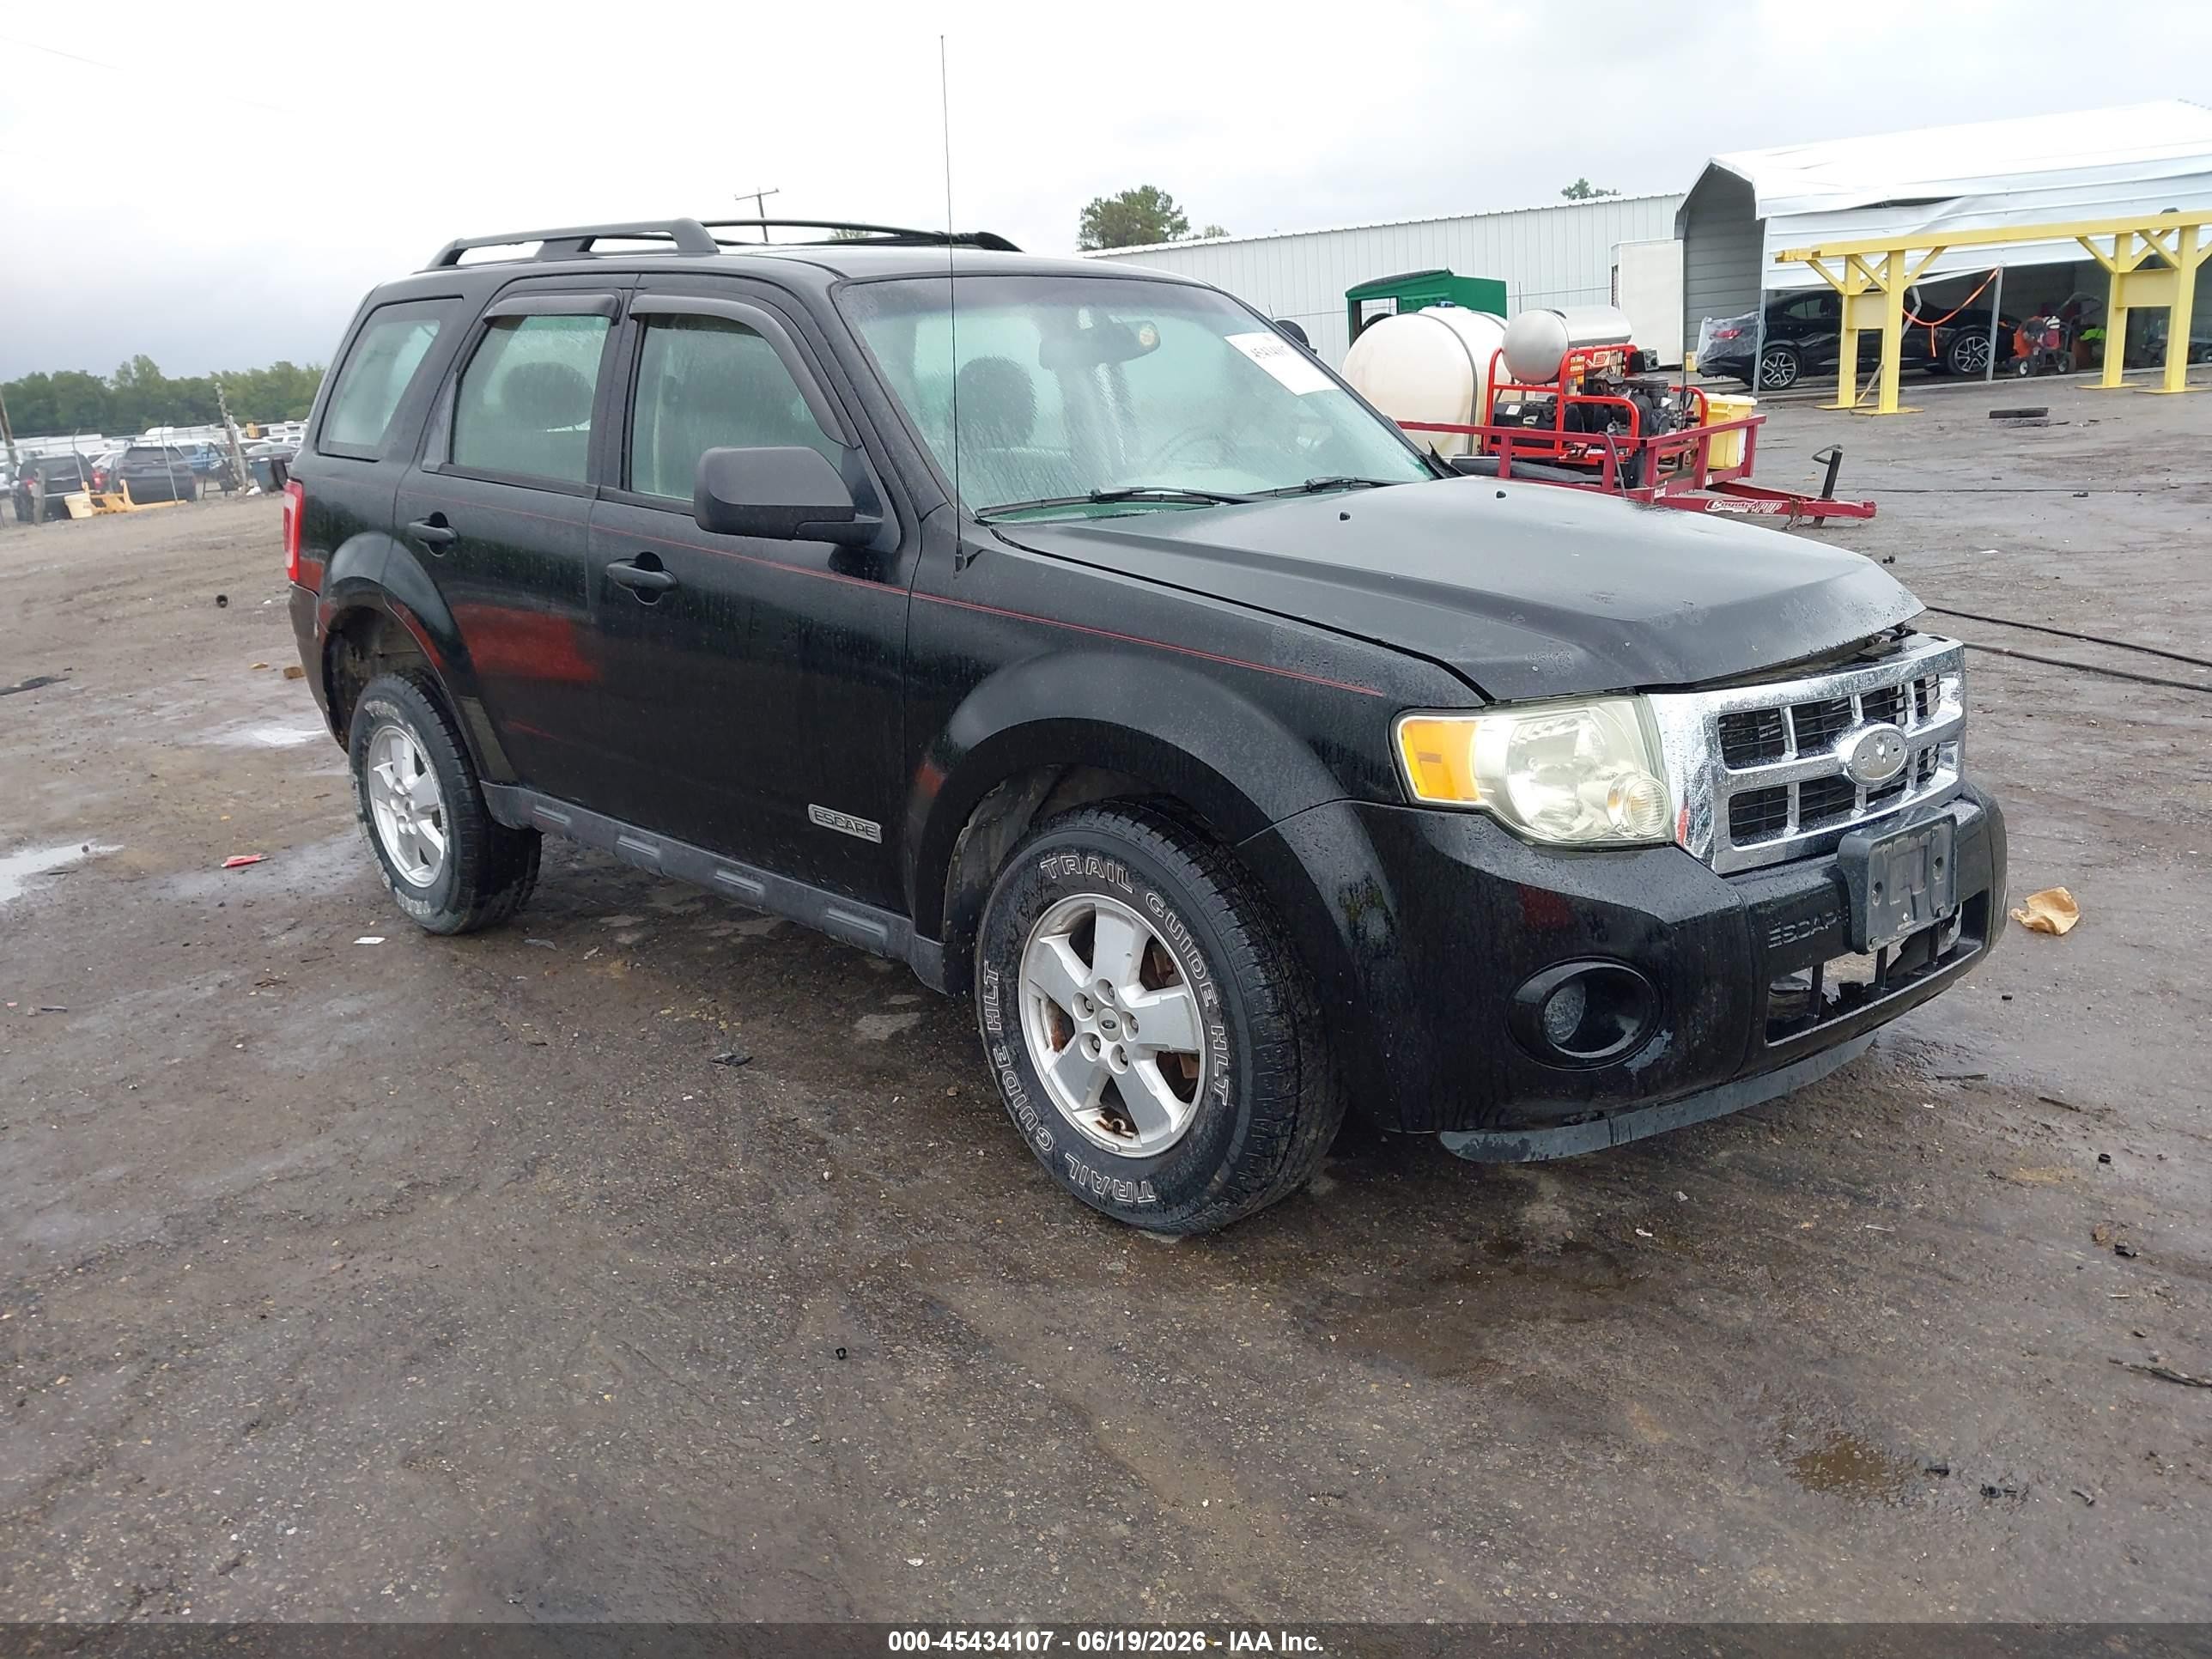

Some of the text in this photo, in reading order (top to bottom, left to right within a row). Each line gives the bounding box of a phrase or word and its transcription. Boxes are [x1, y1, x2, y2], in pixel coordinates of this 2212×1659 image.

[814, 810, 877, 838] ESCAPE
[983, 961, 1157, 1204] TRAIL GUIDE HLT
[1040, 854, 1230, 1106] TRAIL GUIDE HLT
